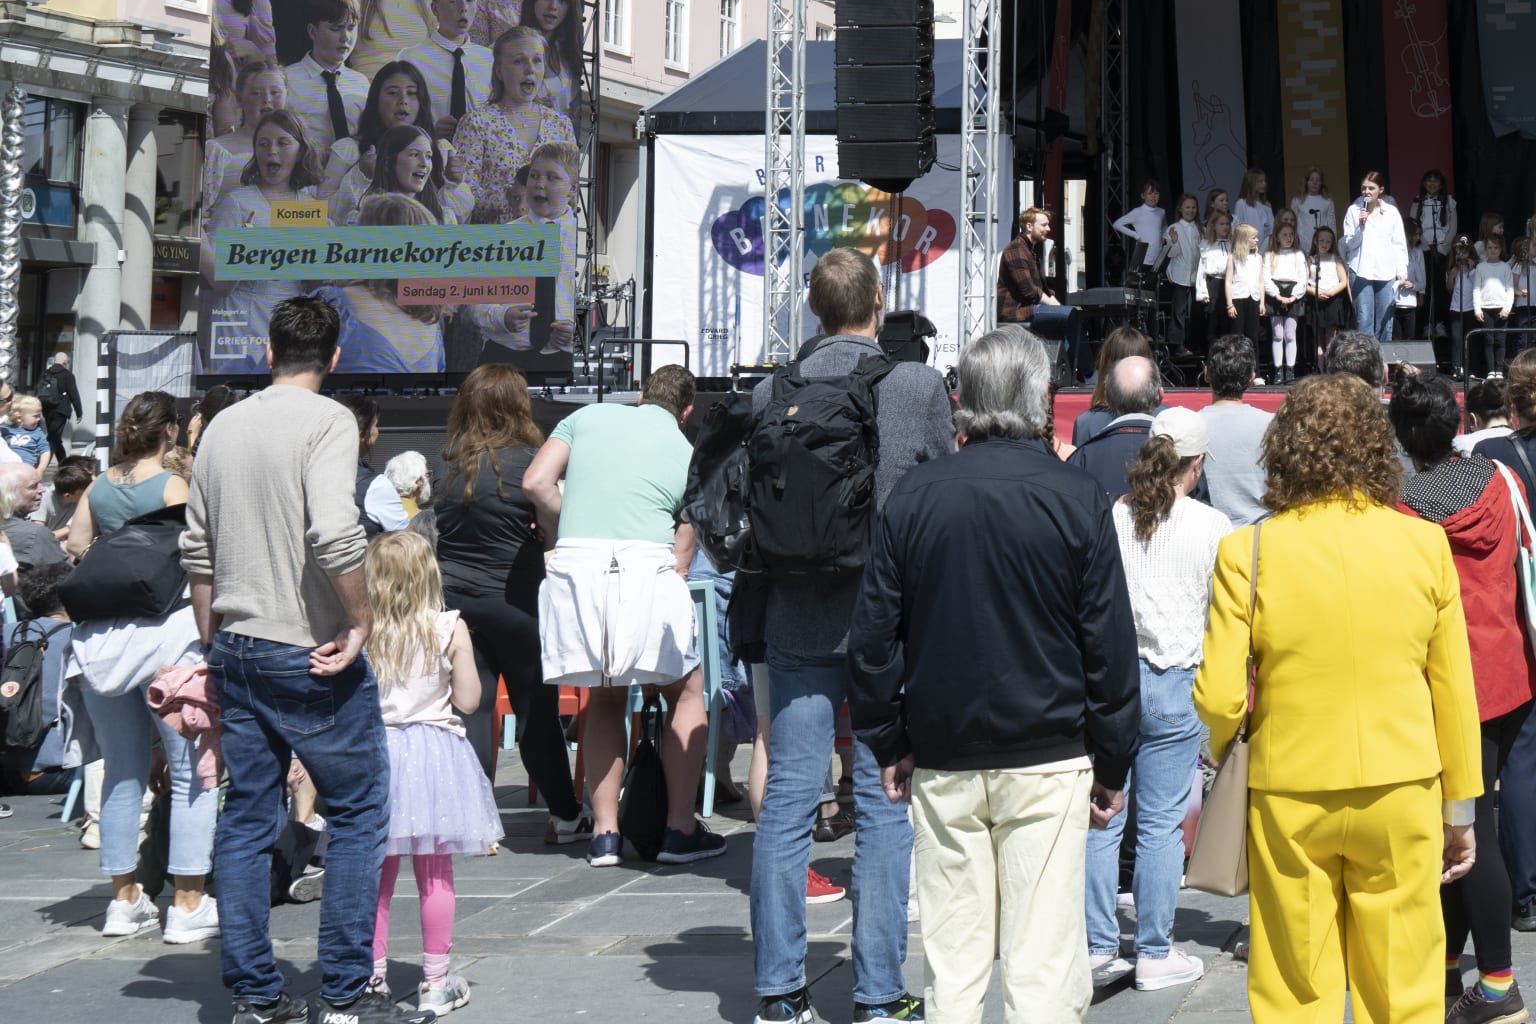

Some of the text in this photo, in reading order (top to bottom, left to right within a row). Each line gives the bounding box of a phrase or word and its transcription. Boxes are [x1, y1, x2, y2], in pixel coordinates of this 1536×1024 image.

[276, 207, 322, 220] Konsert
[169, 246, 190, 260] YING
[226, 240, 546, 271] Bergen Barnekorfestival
[402, 284, 530, 299] Søndag 2. juni kl 11:00
[217, 337, 247, 345] GRIEG
[323, 1012, 359, 1024] HOKA
